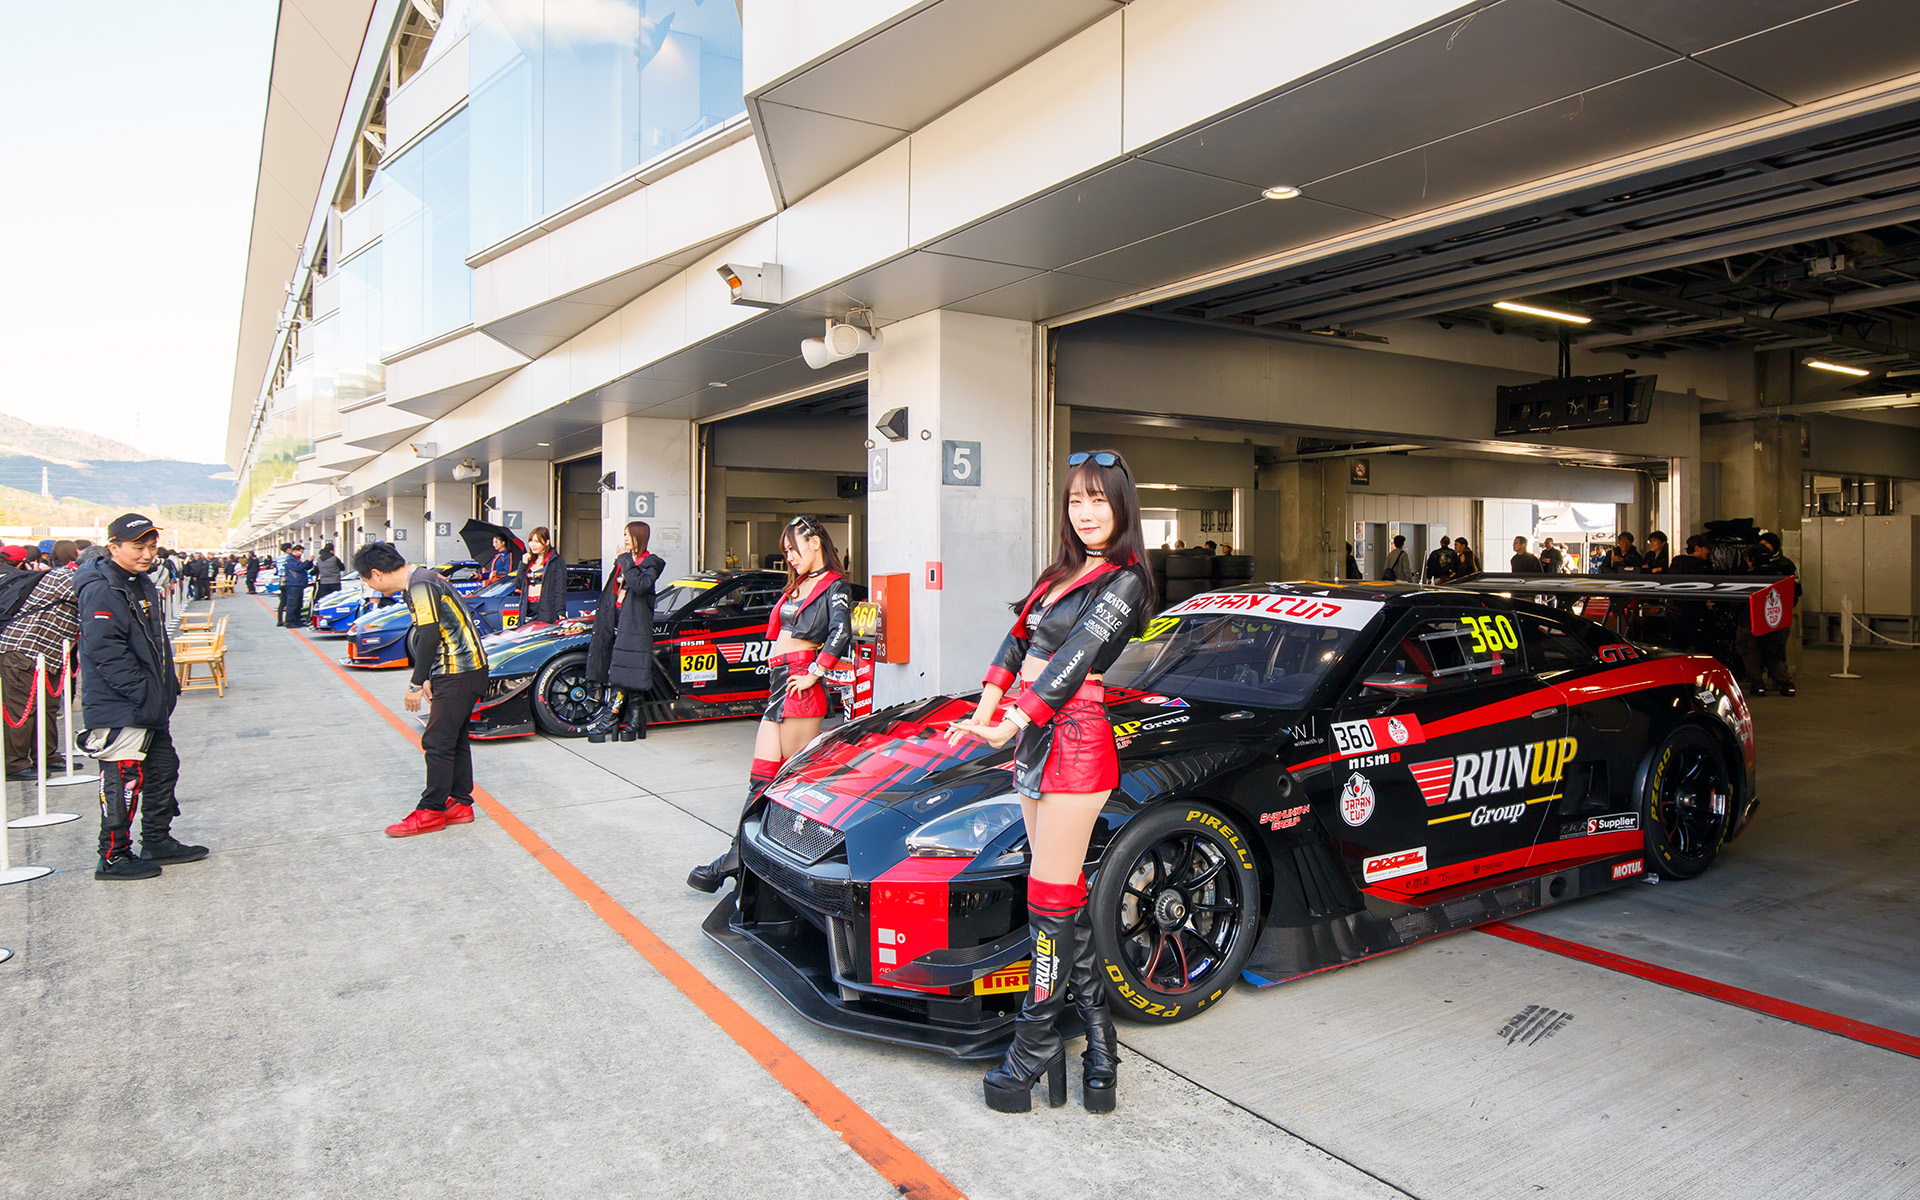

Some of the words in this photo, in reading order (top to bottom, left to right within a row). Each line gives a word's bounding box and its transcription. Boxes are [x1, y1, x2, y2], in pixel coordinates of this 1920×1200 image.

[873, 454, 883, 485] 6
[952, 447, 972, 480] 5
[633, 494, 649, 515] 6
[438, 523, 448, 535] 8
[507, 512, 518, 525] 7
[366, 534, 376, 543] 10
[396, 530, 404, 540] 9
[851, 605, 877, 628] 360
[1170, 594, 1270, 614] JAPAN
[1265, 596, 1343, 620] CUP
[679, 628, 711, 636] NISSAN
[1461, 614, 1519, 654] 360
[683, 654, 716, 672] 360
[1050, 649, 1085, 689] RIVAUX
[1141, 715, 1190, 731] Group
[1333, 723, 1374, 751] 360
[1349, 752, 1401, 770] nismo
[1447, 736, 1578, 803] RUNUP
[1344, 796, 1372, 811] JAPAN
[1271, 815, 1301, 831] GROUP
[1349, 808, 1366, 821] CUP
[1470, 802, 1526, 828] Group
[1598, 816, 1636, 829] Supplier
[1185, 809, 1253, 870] PIRELLI
[1365, 851, 1425, 875] DIXCEL
[1613, 860, 1642, 879] MOTUL
[1034, 930, 1052, 992] RUNUP
[1050, 956, 1061, 981] Group
